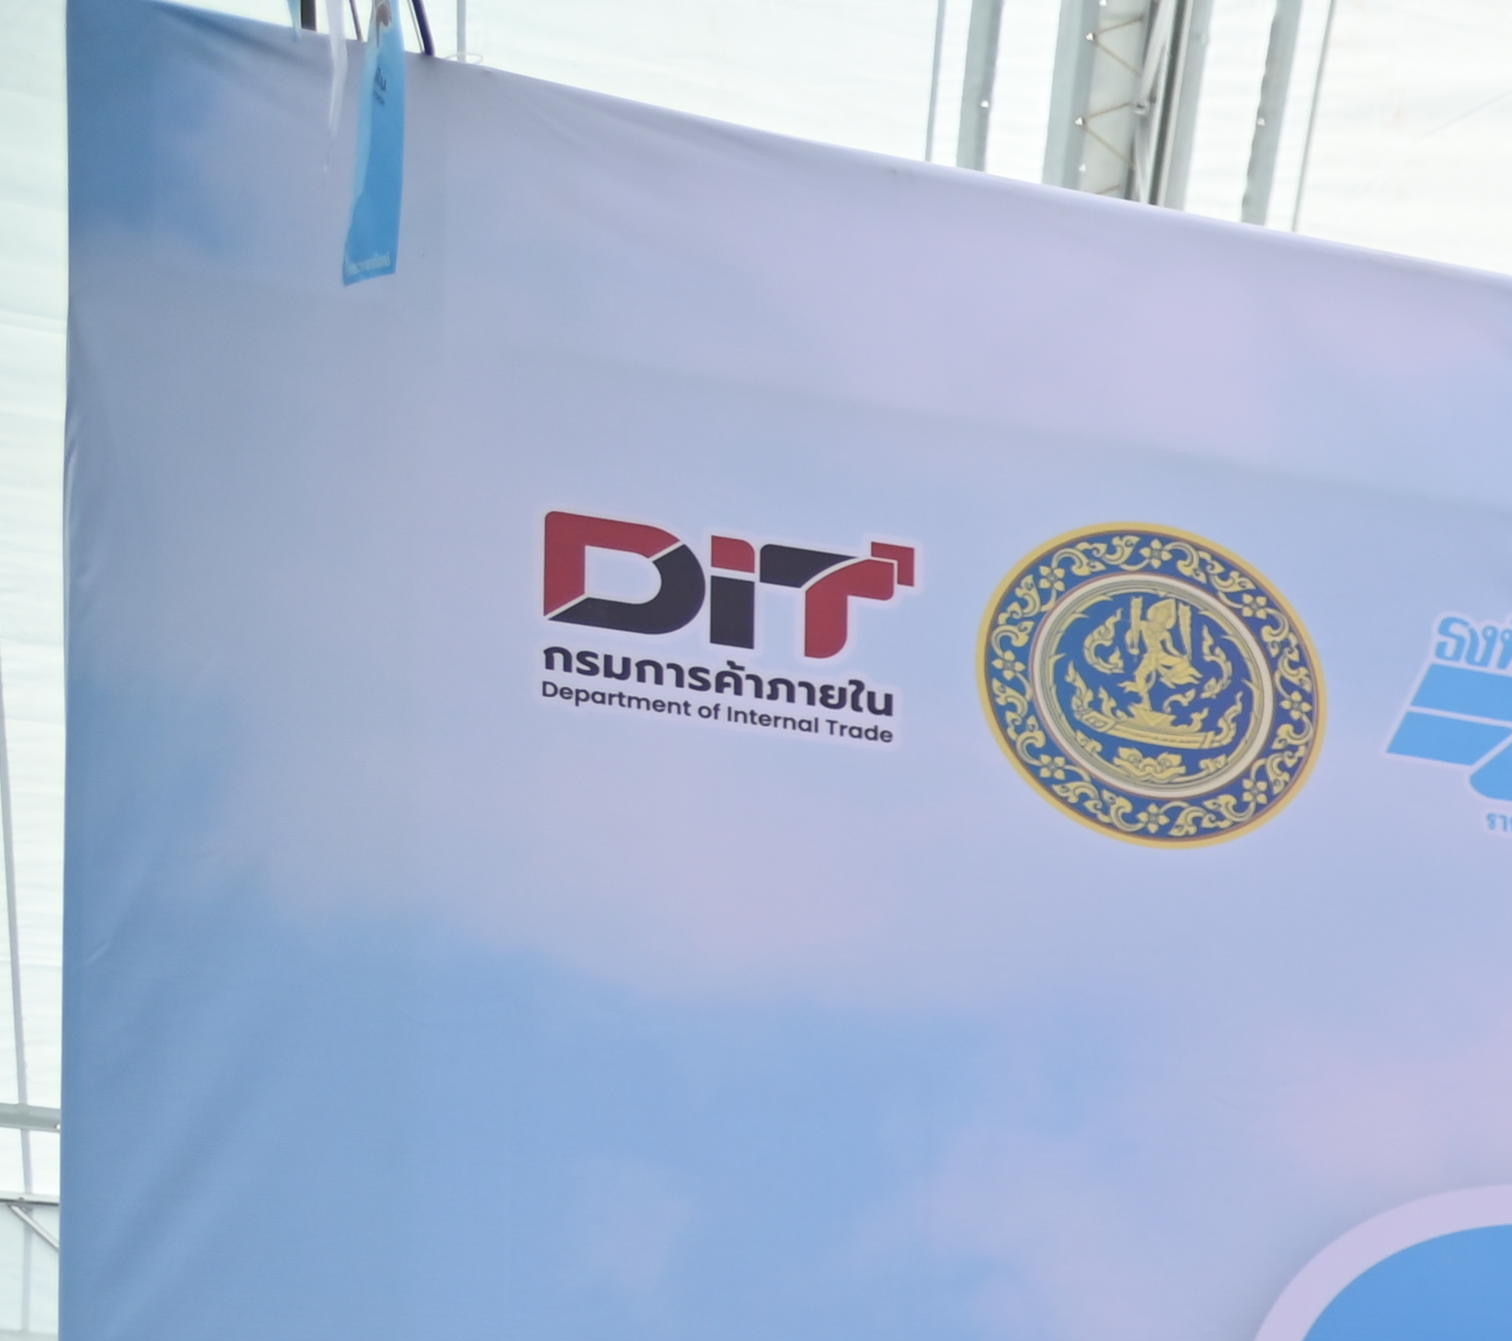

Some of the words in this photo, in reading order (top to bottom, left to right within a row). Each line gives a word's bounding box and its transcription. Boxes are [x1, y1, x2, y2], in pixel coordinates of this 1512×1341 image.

[541, 680, 692, 717] Department
[697, 703, 721, 721] of
[727, 705, 820, 734] Internal
[825, 718, 895, 744] Trade
[543, 645, 895, 717] กรมการค้าภายใน
